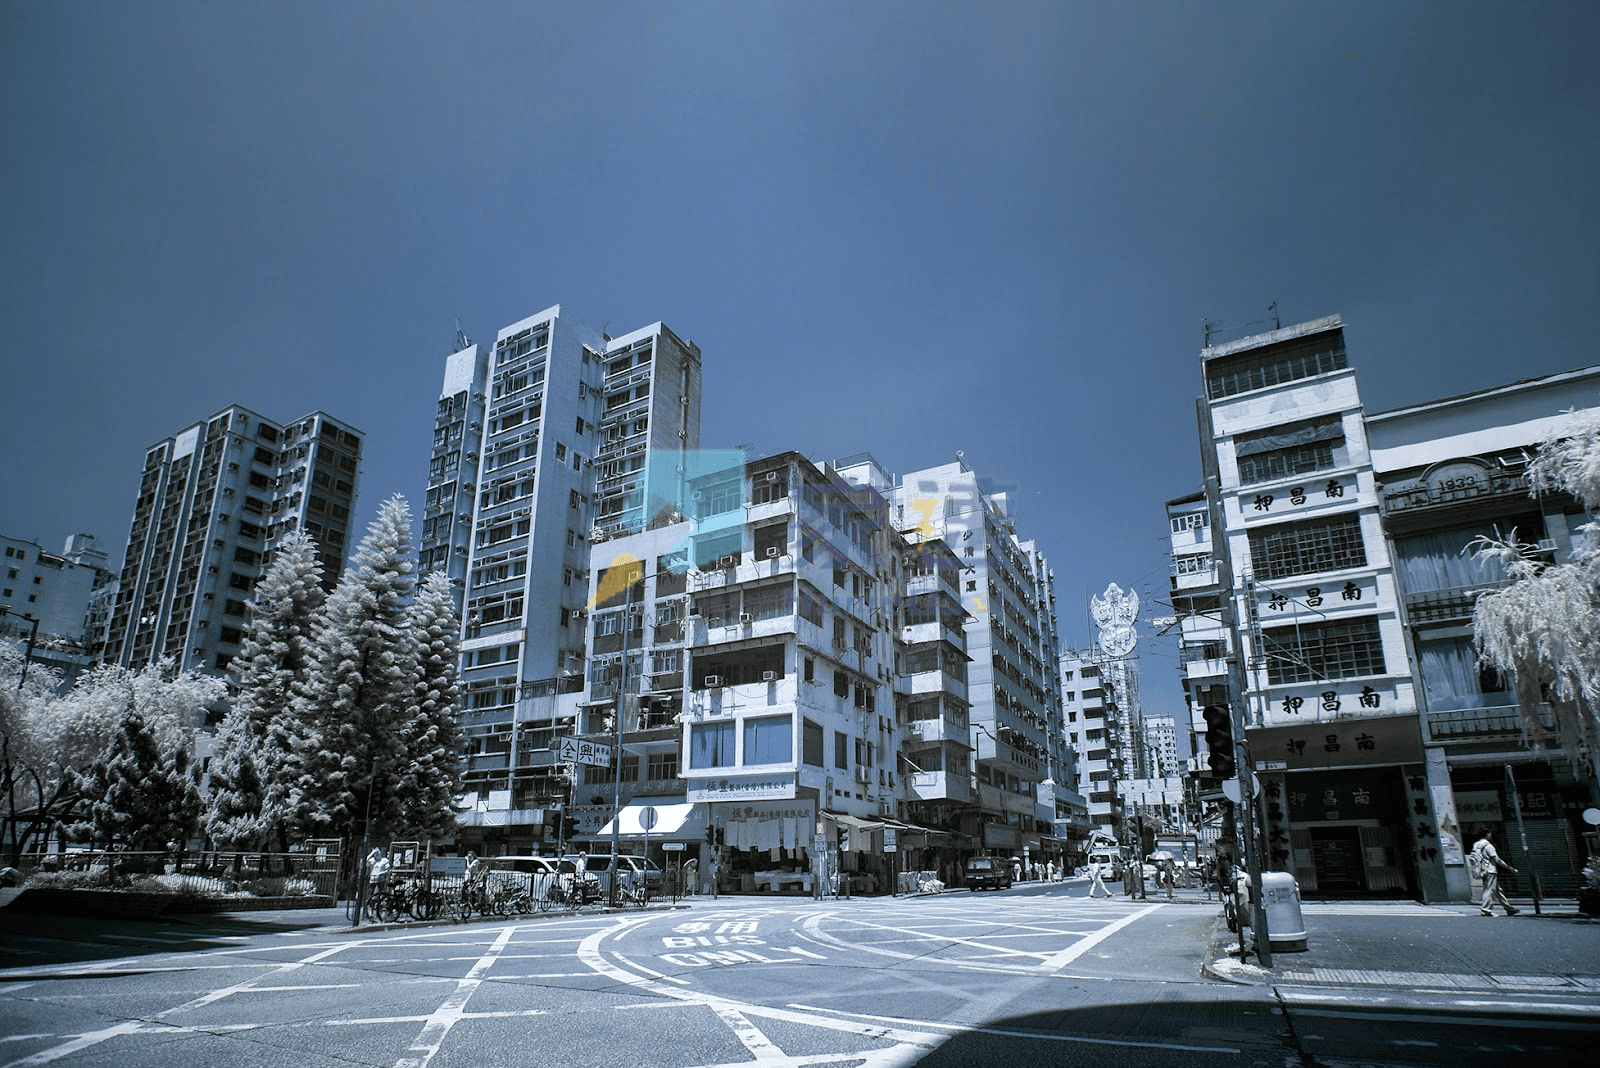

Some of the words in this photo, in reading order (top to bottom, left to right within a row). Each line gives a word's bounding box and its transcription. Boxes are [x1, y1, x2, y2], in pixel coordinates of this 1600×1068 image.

[1439, 476, 1475, 491] 1933
[1263, 780, 1289, 866] 南昌大押
[1408, 775, 1437, 863] 南昌大押
[662, 935, 768, 948] BUS
[659, 946, 829, 967] ONLY
